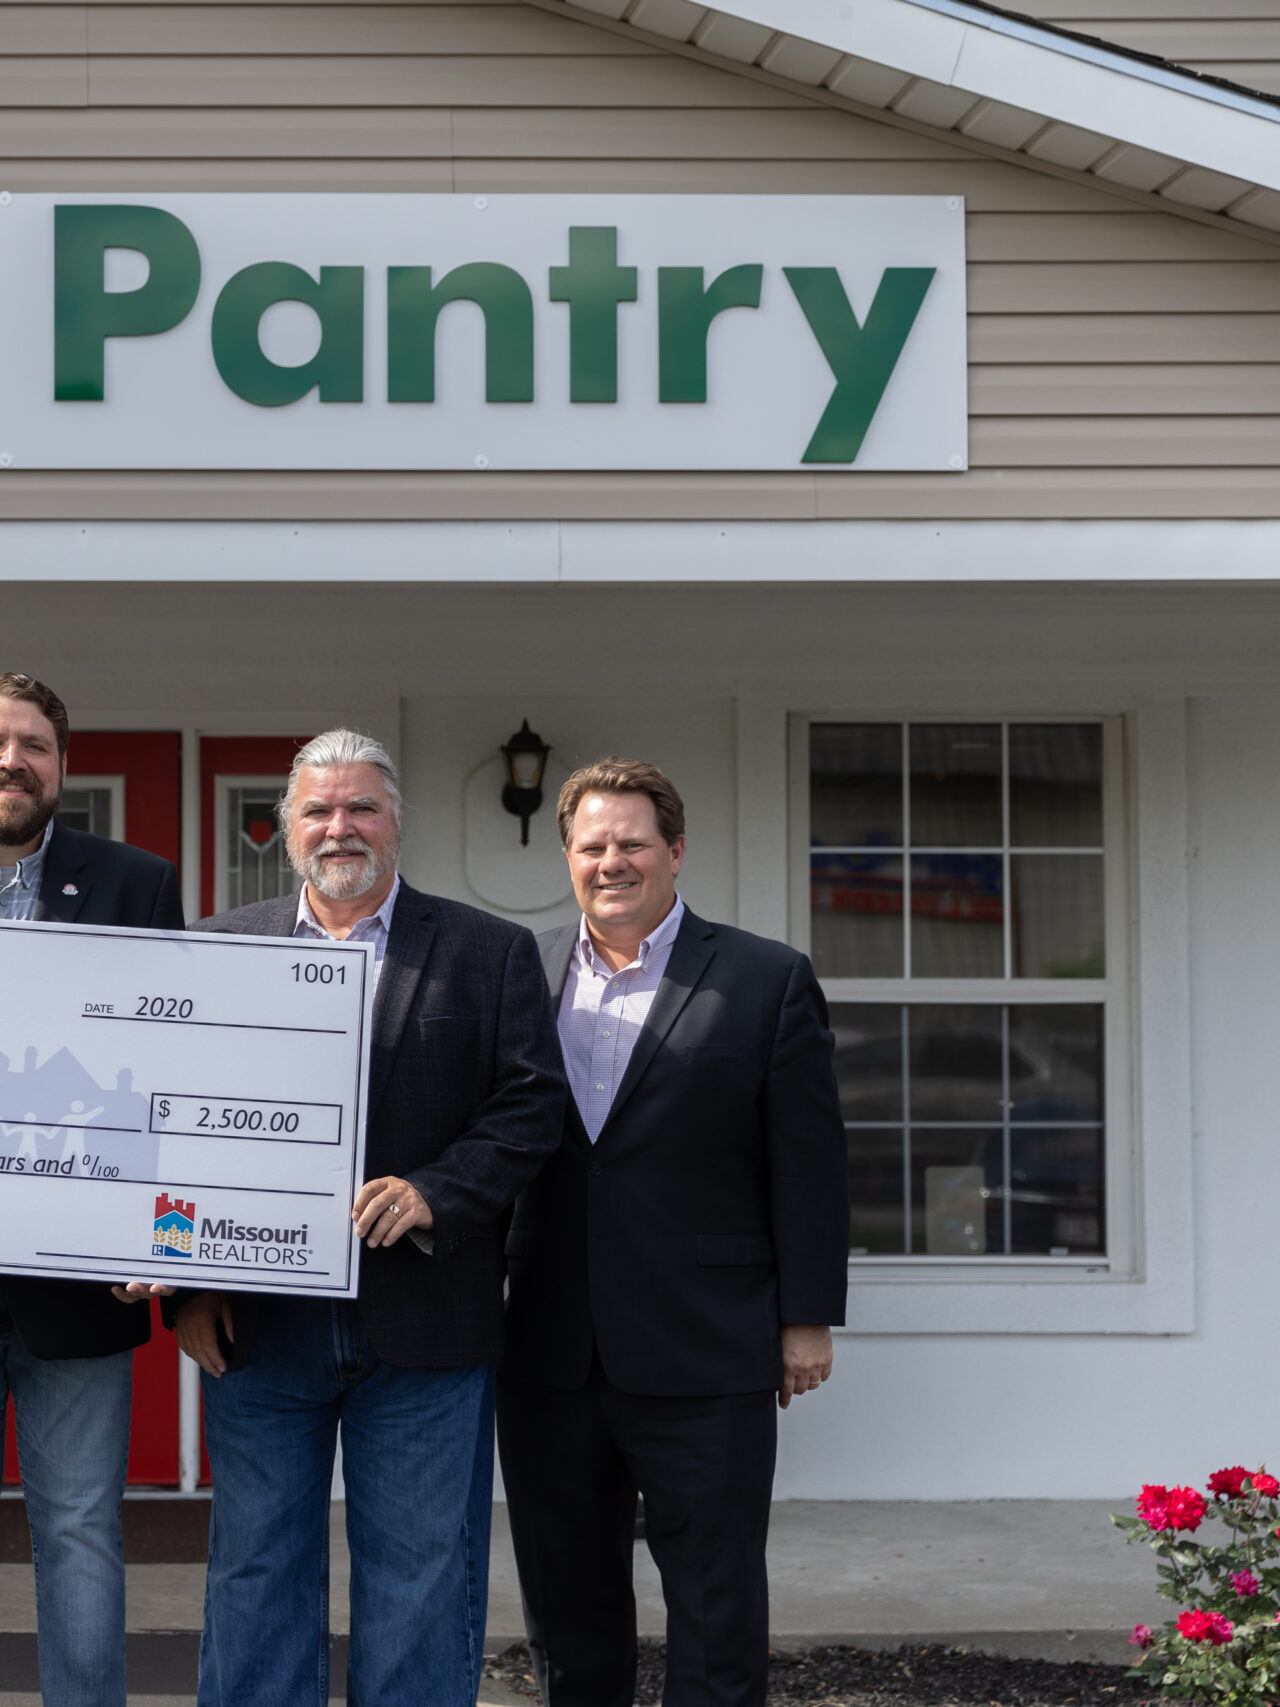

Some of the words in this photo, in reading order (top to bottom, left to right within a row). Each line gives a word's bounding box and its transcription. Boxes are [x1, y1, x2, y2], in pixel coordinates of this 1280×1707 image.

[54, 204, 937, 463] Pantry
[290, 962, 346, 985] 1001
[84, 1002, 114, 1014] DATE
[134, 995, 194, 1019] 2020
[158, 1099, 171, 1119] $
[195, 1106, 300, 1133] 2,500.00
[33, 1154, 75, 1175] and
[200, 1218, 308, 1245] Missouri
